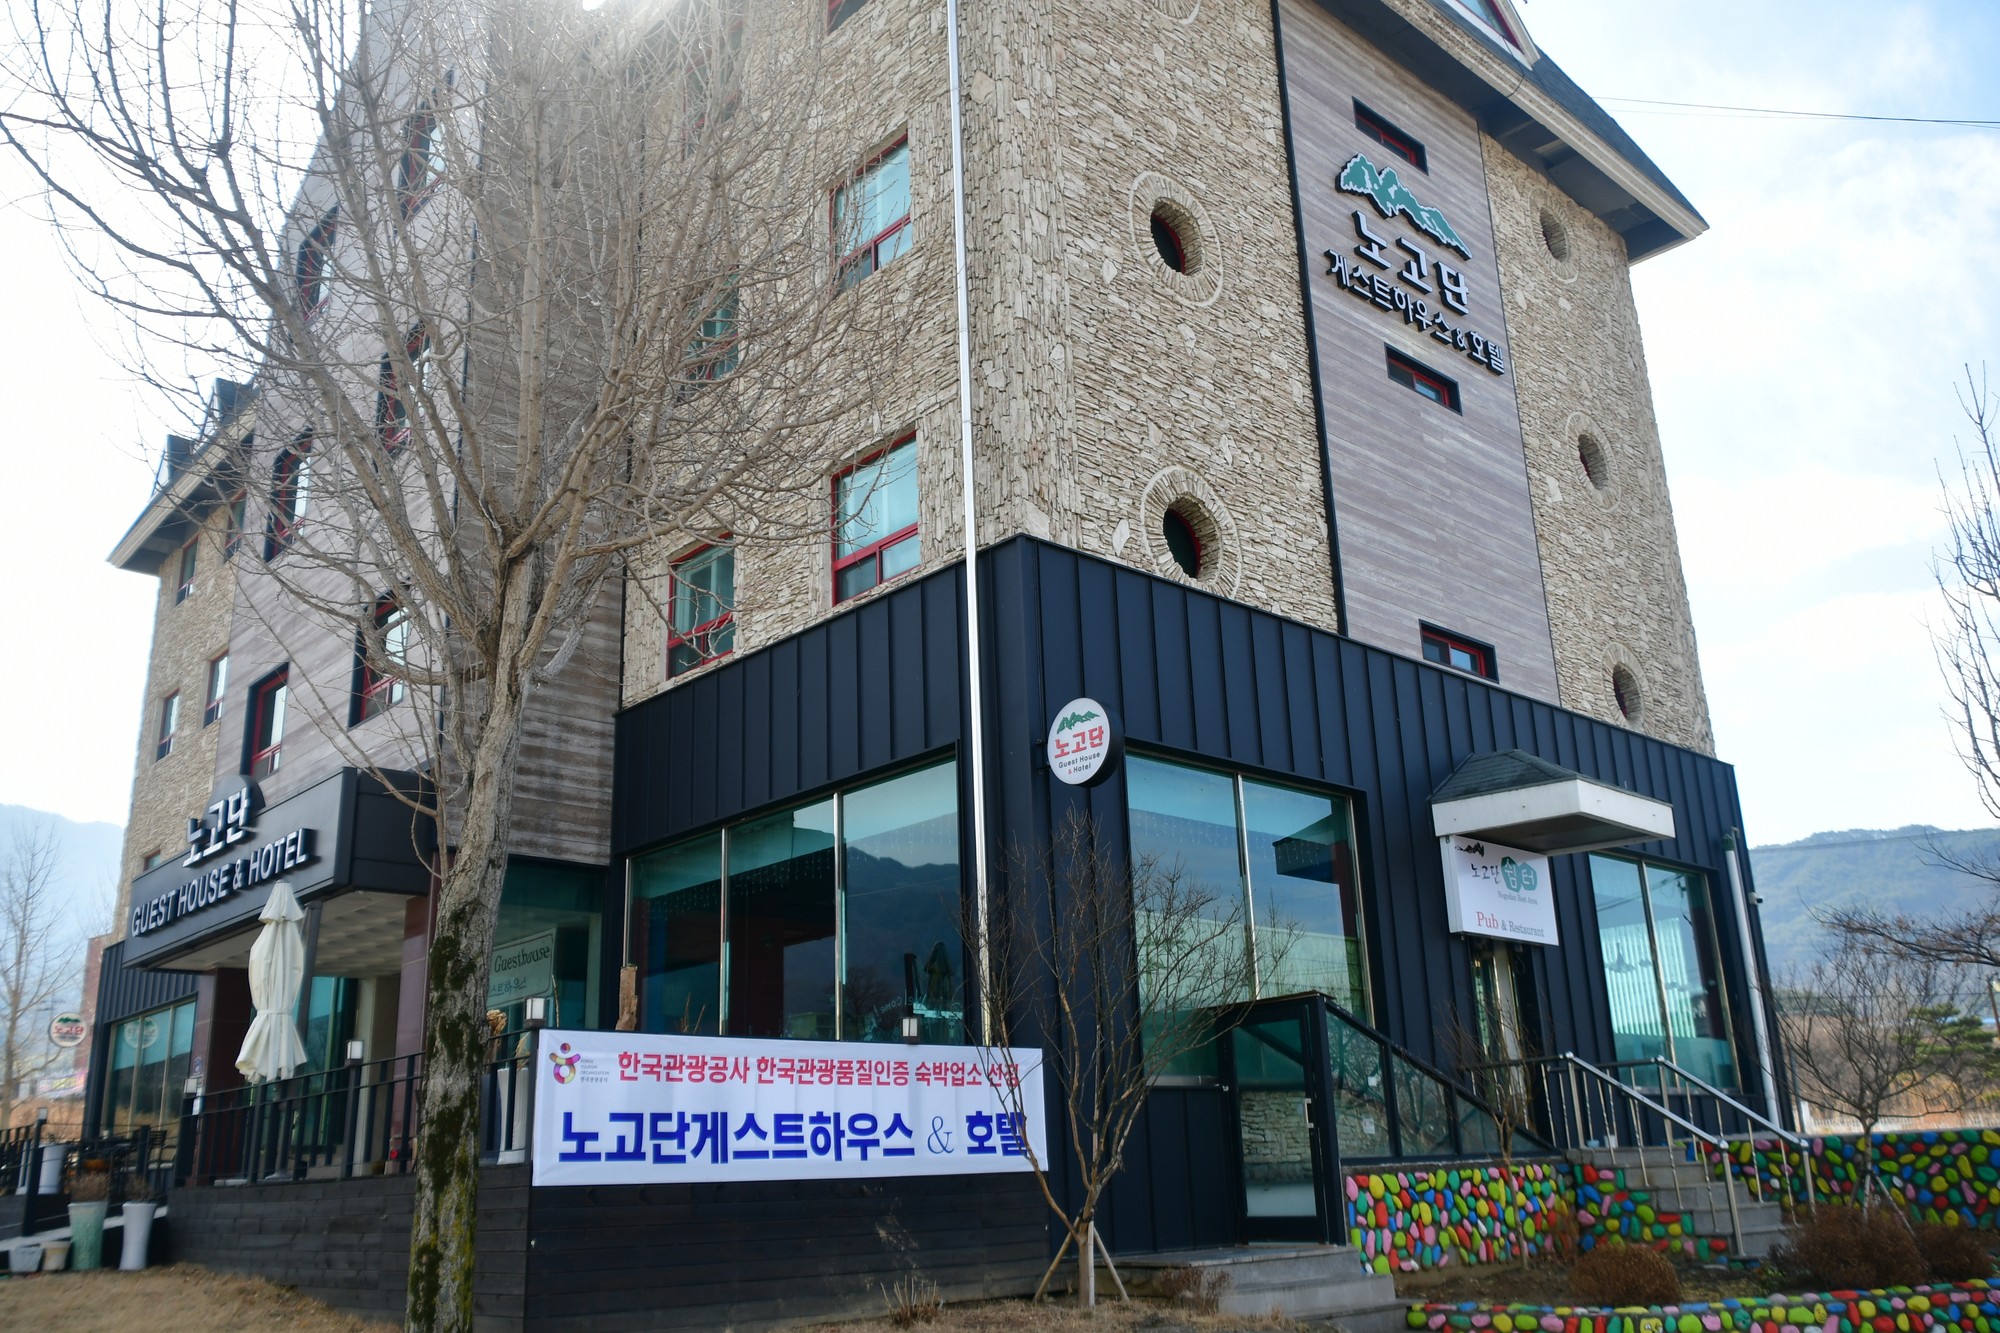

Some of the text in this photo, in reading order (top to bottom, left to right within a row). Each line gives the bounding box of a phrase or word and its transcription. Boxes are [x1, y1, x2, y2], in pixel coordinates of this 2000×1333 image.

[1352, 210, 1469, 315] 노고단
[1054, 725, 1104, 759] 노고단
[1058, 751, 1101, 769] Guest House
[1073, 763, 1092, 773] Hotel
[183, 786, 252, 867] 노고단
[131, 828, 310, 937] GUEST HOUSE & HOTEL
[1471, 858, 1535, 889] 노고단 쉼터
[1476, 912, 1544, 937] Pub & Restaurant
[494, 945, 550, 973] Guesthouse
[617, 1051, 750, 1085] 한국관광공사
[756, 1055, 909, 1087] 한국관광품질인증
[915, 1061, 982, 1087] 숙박업소
[558, 1111, 1028, 1165] 노고단게스트하우스 & 호텔
